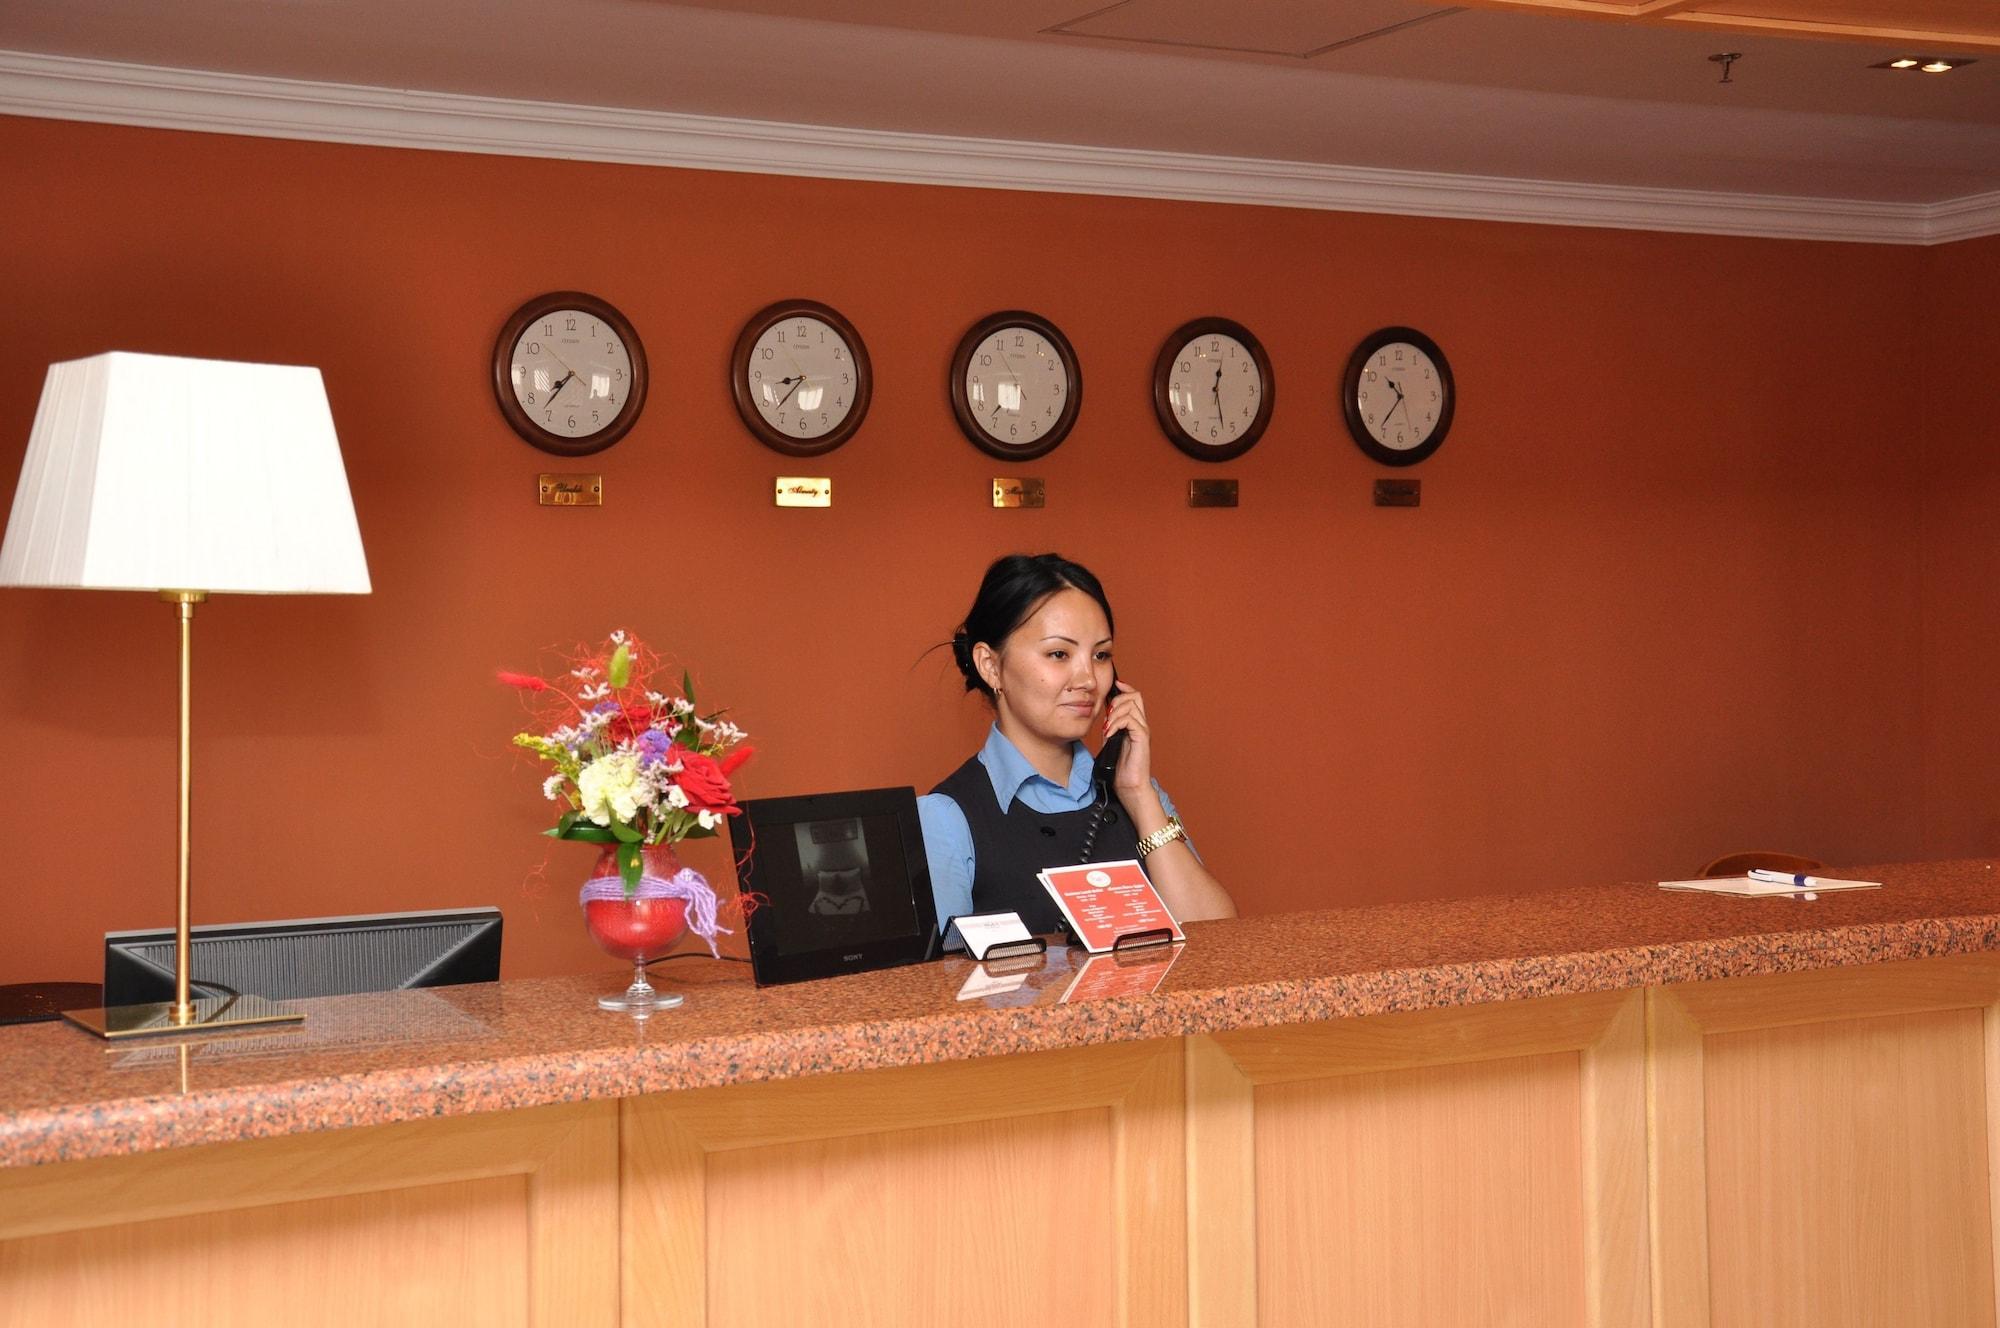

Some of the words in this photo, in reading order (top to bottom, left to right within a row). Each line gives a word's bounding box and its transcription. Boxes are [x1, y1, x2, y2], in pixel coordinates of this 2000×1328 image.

[566, 319, 576, 330] 12
[544, 325, 553, 336] 11
[797, 326, 806, 337] 12
[778, 332, 785, 342] 11
[1015, 336, 1024, 346] 12
[526, 343, 539, 354] 10
[606, 343, 614, 354] 2
[996, 340, 1004, 350] 11
[1211, 342, 1219, 352] 12
[762, 348, 773, 360] 10
[834, 348, 840, 359] 2
[1195, 347, 1200, 357] 11
[1395, 351, 1403, 360] 12
[981, 355, 992, 366] 10
[1048, 360, 1054, 370] 2
[1380, 356, 1386, 366] 11
[520, 367, 526, 377] 9
[1181, 362, 1191, 372] 10
[1243, 362, 1248, 372] 2
[616, 369, 622, 381] 3
[755, 371, 761, 382] 9
[843, 373, 848, 384] 3
[1367, 371, 1377, 382] 10
[1425, 369, 1429, 379] 2
[1054, 384, 1059, 395] 3
[1174, 383, 1180, 392] 9
[1249, 385, 1254, 396] 3
[528, 392, 535, 404] 8
[609, 394, 615, 404] 4
[1362, 392, 1367, 402] 9
[1431, 391, 1436, 401] 3
[836, 398, 841, 406] 4
[545, 410, 552, 422] 7
[1046, 406, 1051, 416] 4
[1181, 406, 1186, 416] 8
[1243, 408, 1248, 416] 4
[568, 415, 576, 428] 6
[592, 411, 598, 422] 5
[780, 413, 785, 424] 7
[821, 414, 827, 424] 5
[1368, 414, 1373, 424] 8
[1426, 412, 1430, 421] 4
[800, 418, 807, 430] 6
[992, 417, 997, 428] 7
[1032, 421, 1037, 432] 5
[1194, 422, 1199, 432] 7
[1230, 422, 1235, 432] 5
[1010, 424, 1016, 435] 6
[1211, 426, 1217, 437] 6
[1382, 428, 1386, 438] 7
[1415, 427, 1419, 437] 5
[1397, 432, 1403, 443] 6
[843, 954, 864, 962] SONY
